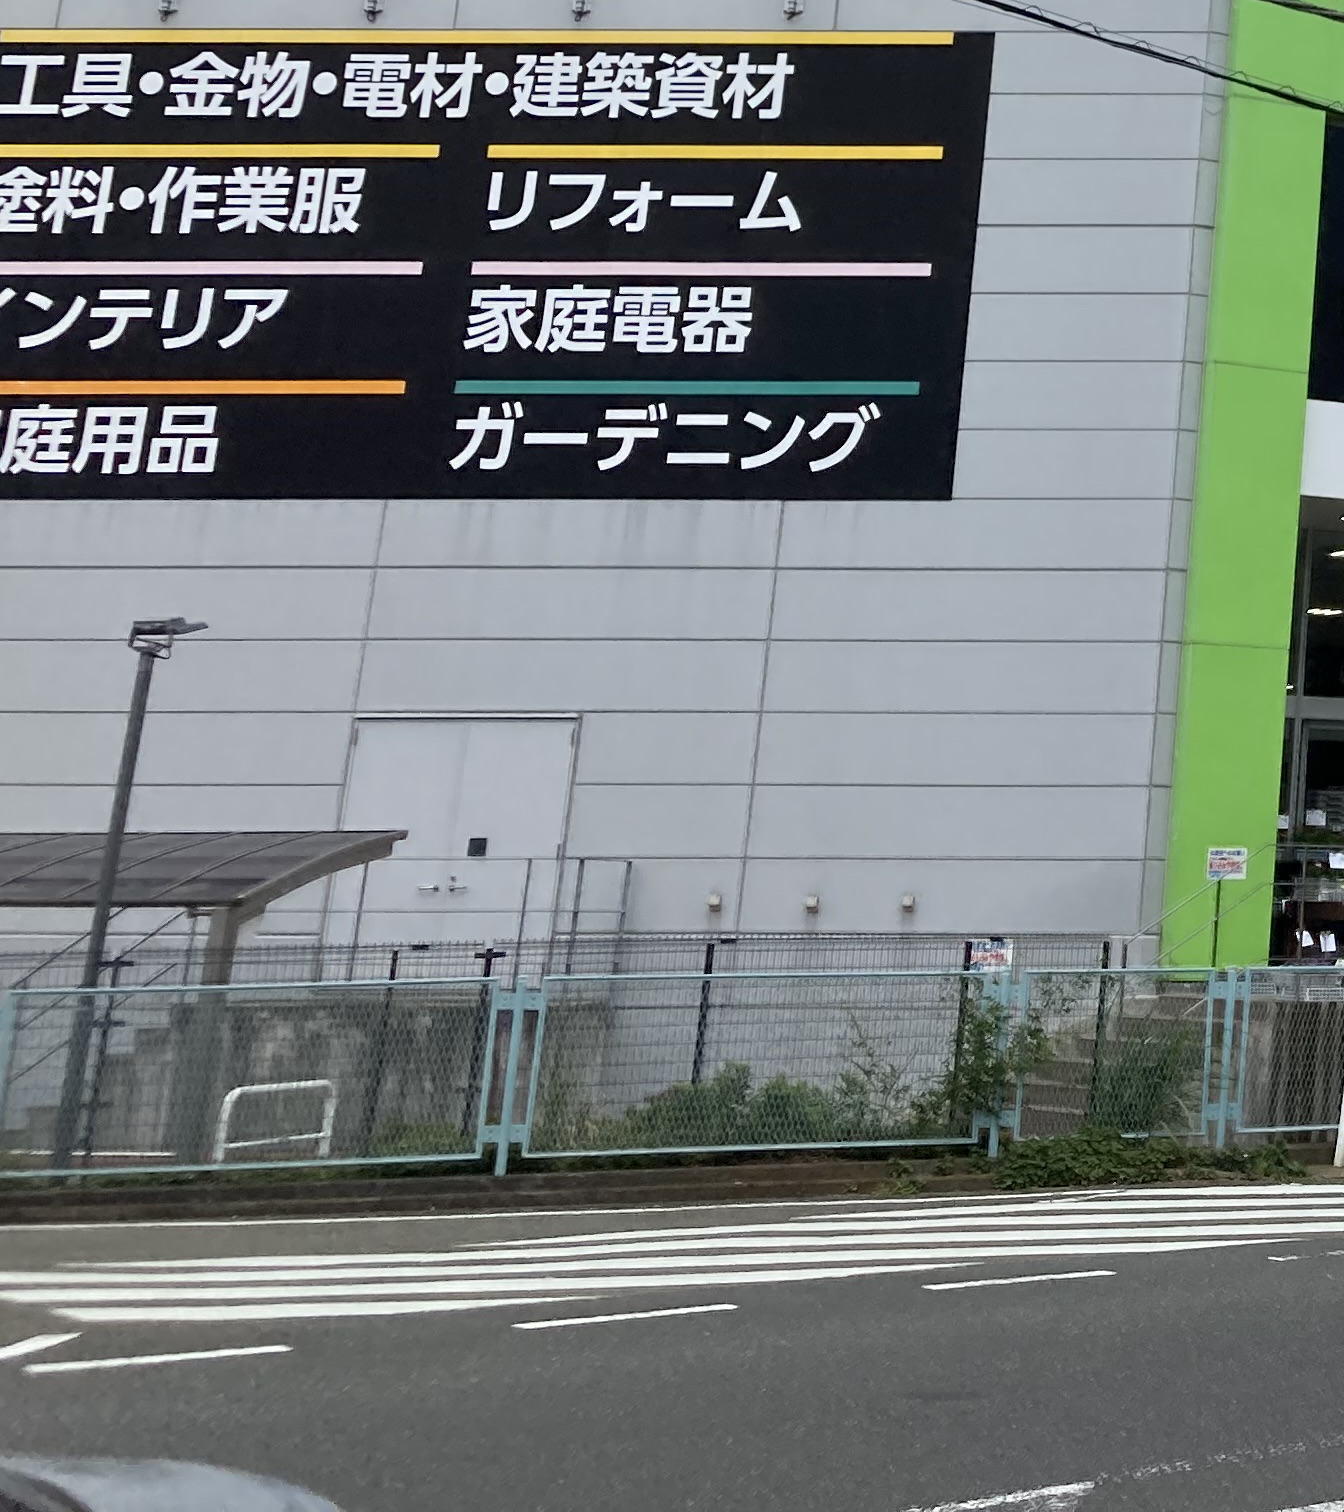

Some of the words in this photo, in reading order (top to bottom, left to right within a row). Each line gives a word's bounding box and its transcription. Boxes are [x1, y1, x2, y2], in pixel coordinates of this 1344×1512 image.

[486, 170, 802, 233] リフォーム
[463, 283, 753, 353] 家庭電器
[0, 402, 219, 475] 庭用品
[448, 401, 882, 473] ガーデニング
